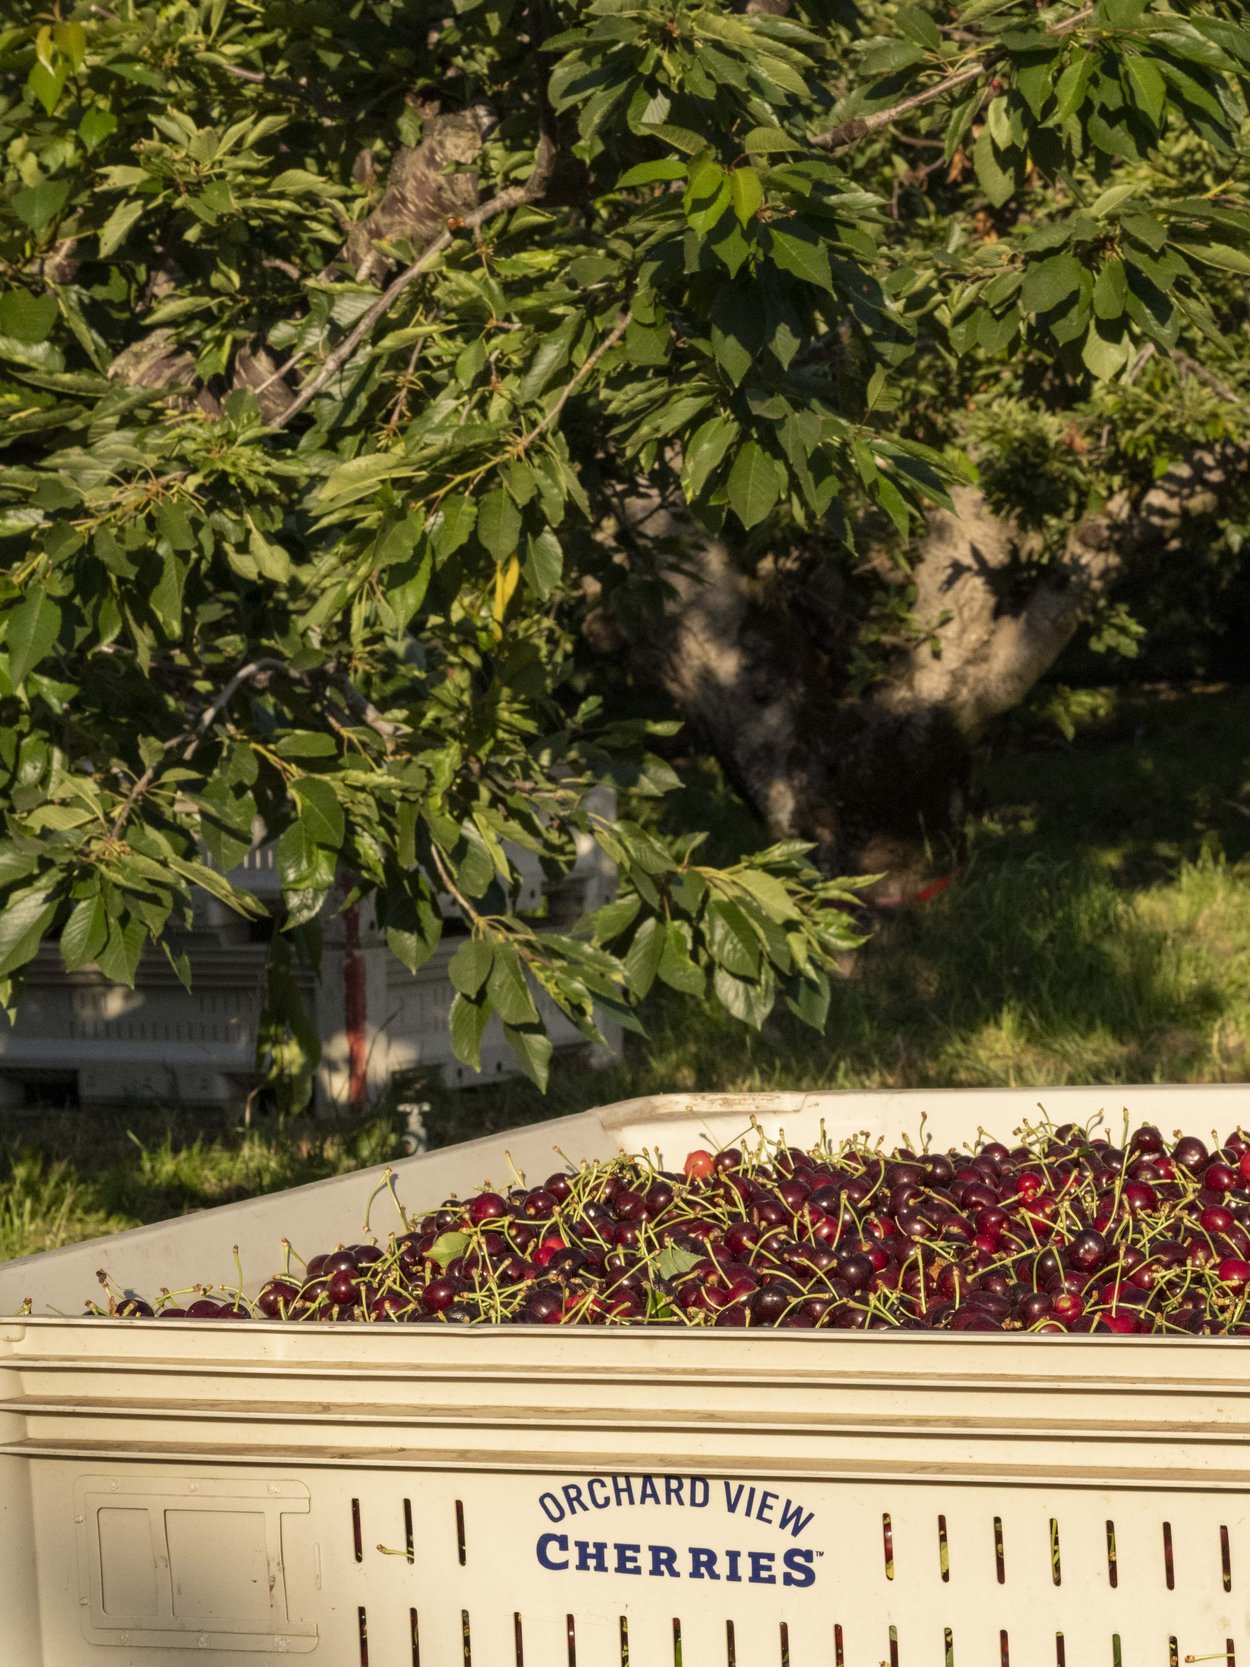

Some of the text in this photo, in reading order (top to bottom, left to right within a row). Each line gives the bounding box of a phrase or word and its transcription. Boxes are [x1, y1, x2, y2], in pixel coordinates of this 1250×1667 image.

[538, 1474, 815, 1538] ORCHARD VIEW
[536, 1532, 816, 1588] CHERRIES
